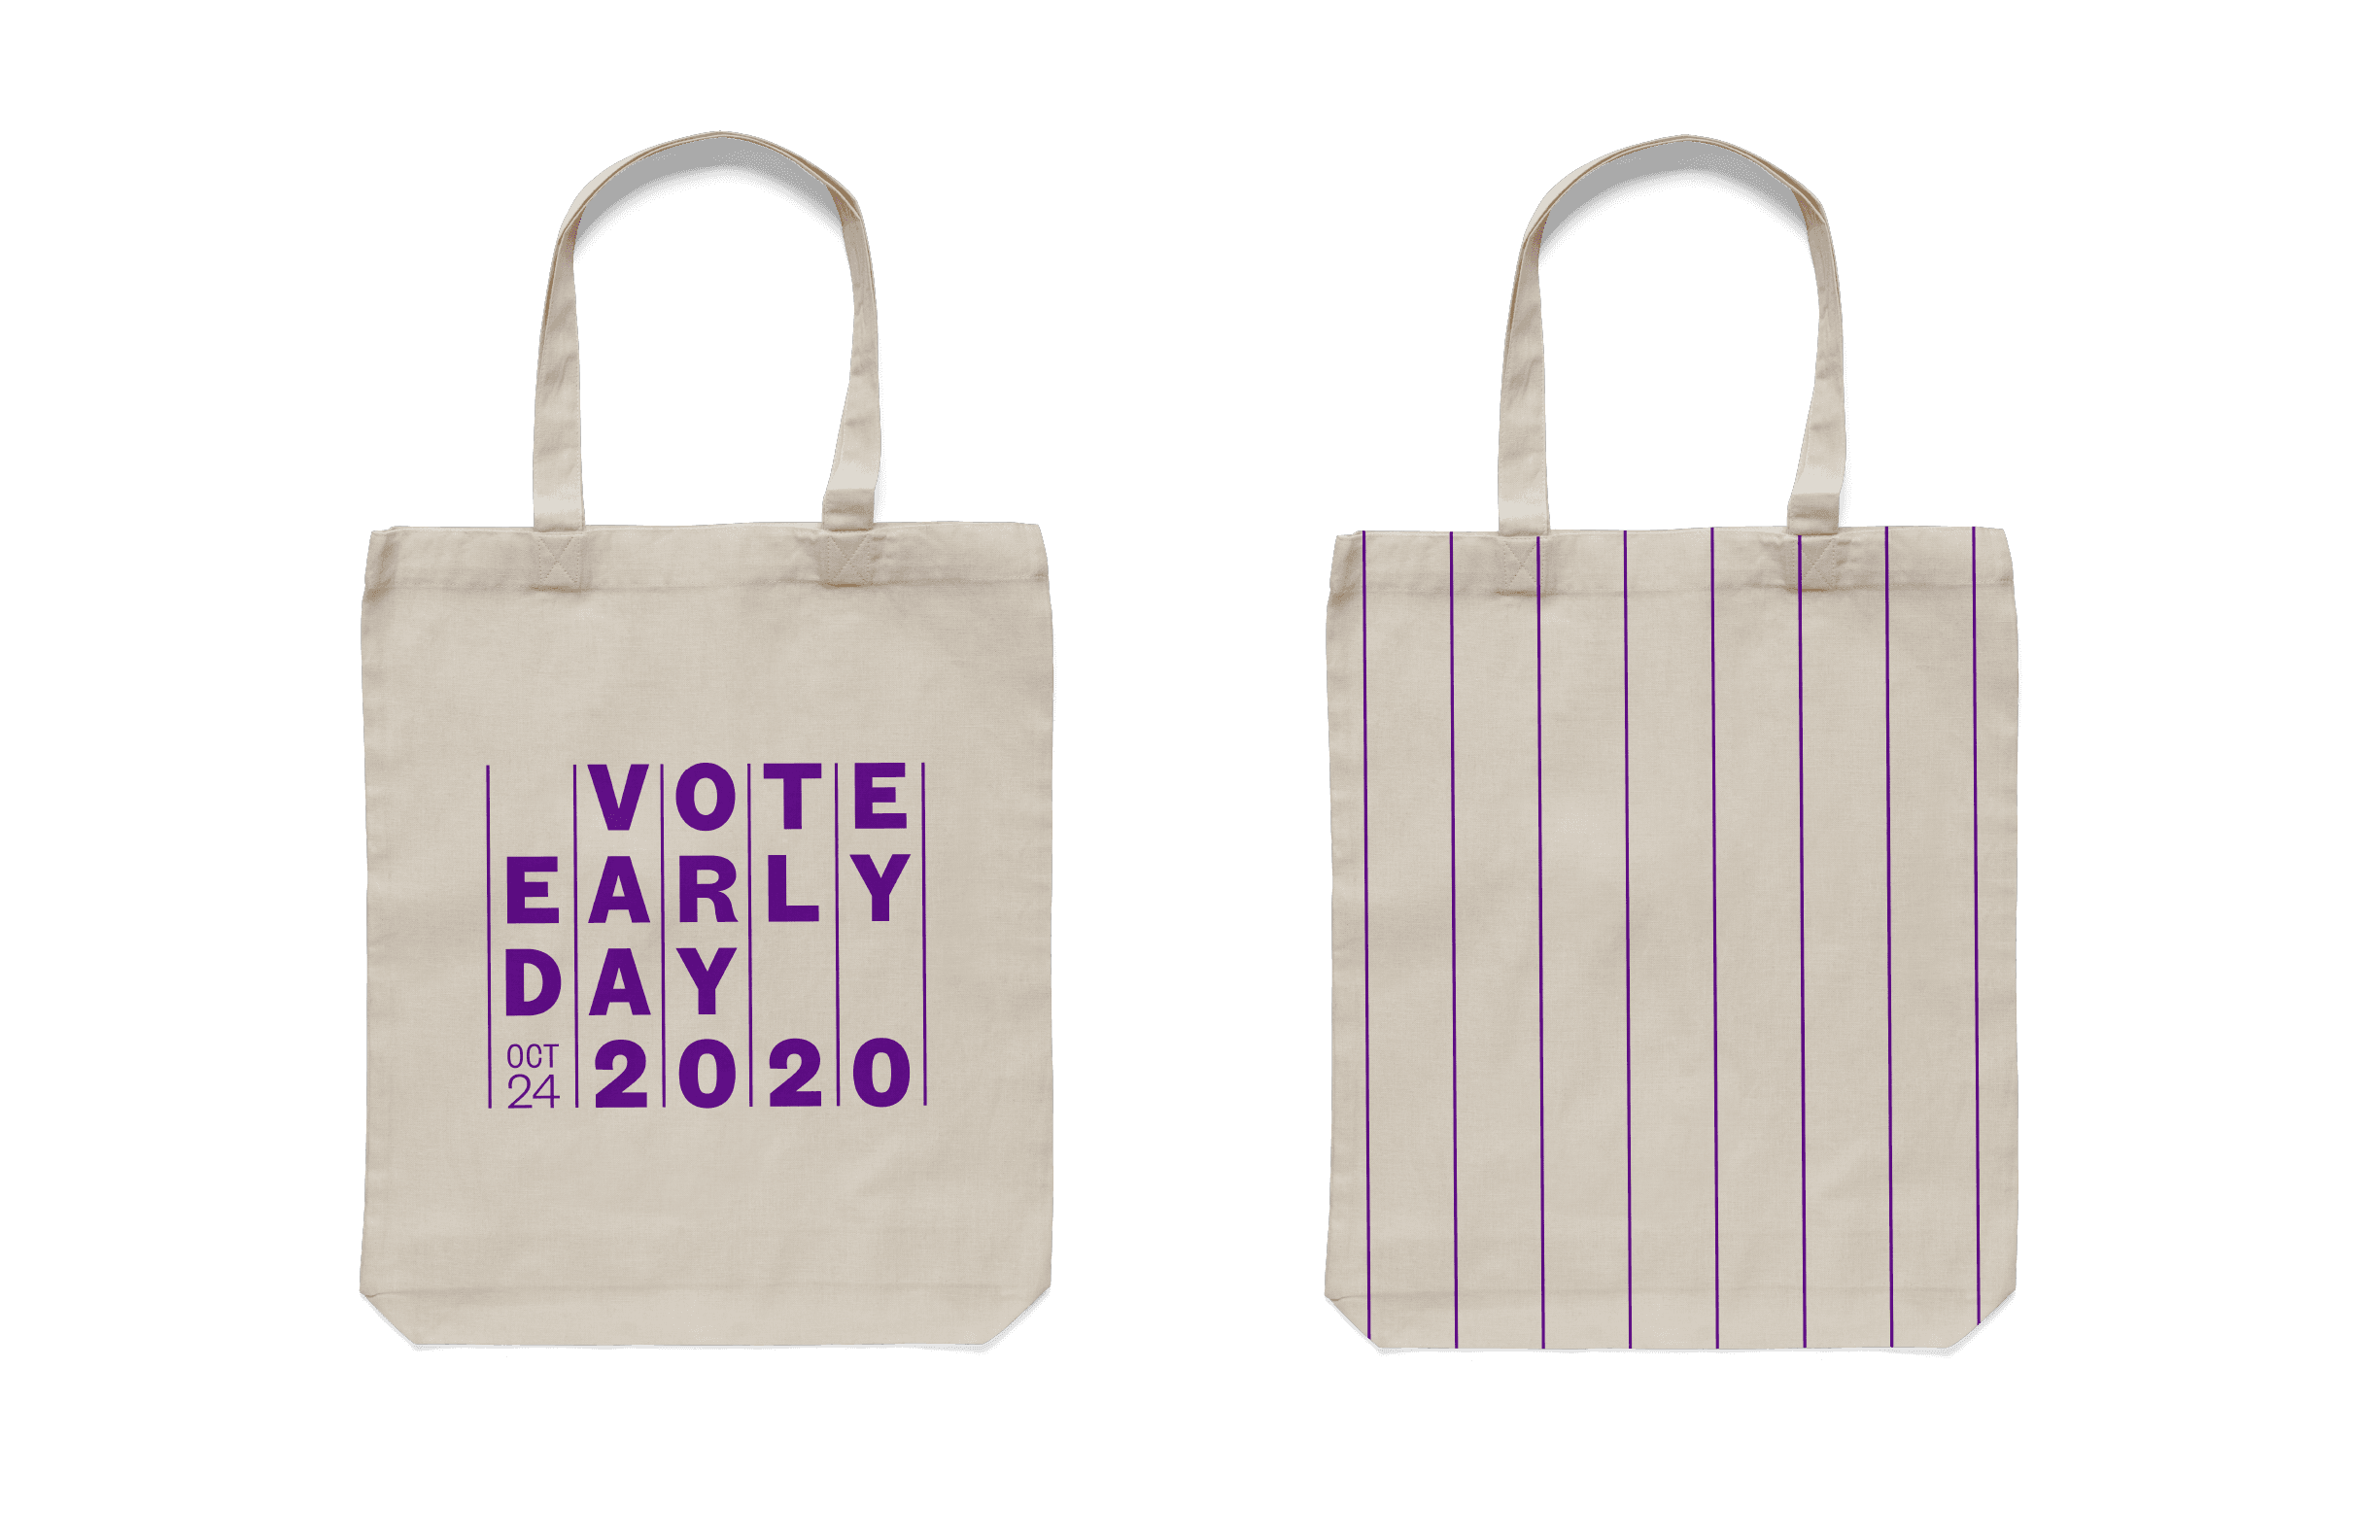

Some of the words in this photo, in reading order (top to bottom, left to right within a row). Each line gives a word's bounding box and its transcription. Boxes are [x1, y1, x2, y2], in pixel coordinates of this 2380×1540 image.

[586, 763, 908, 831] VOTE
[506, 854, 912, 924] EARLY
[504, 947, 738, 1017] DAY
[506, 1044, 560, 1069] OCT
[594, 1038, 911, 1110] 2020
[507, 1074, 561, 1110] 24
